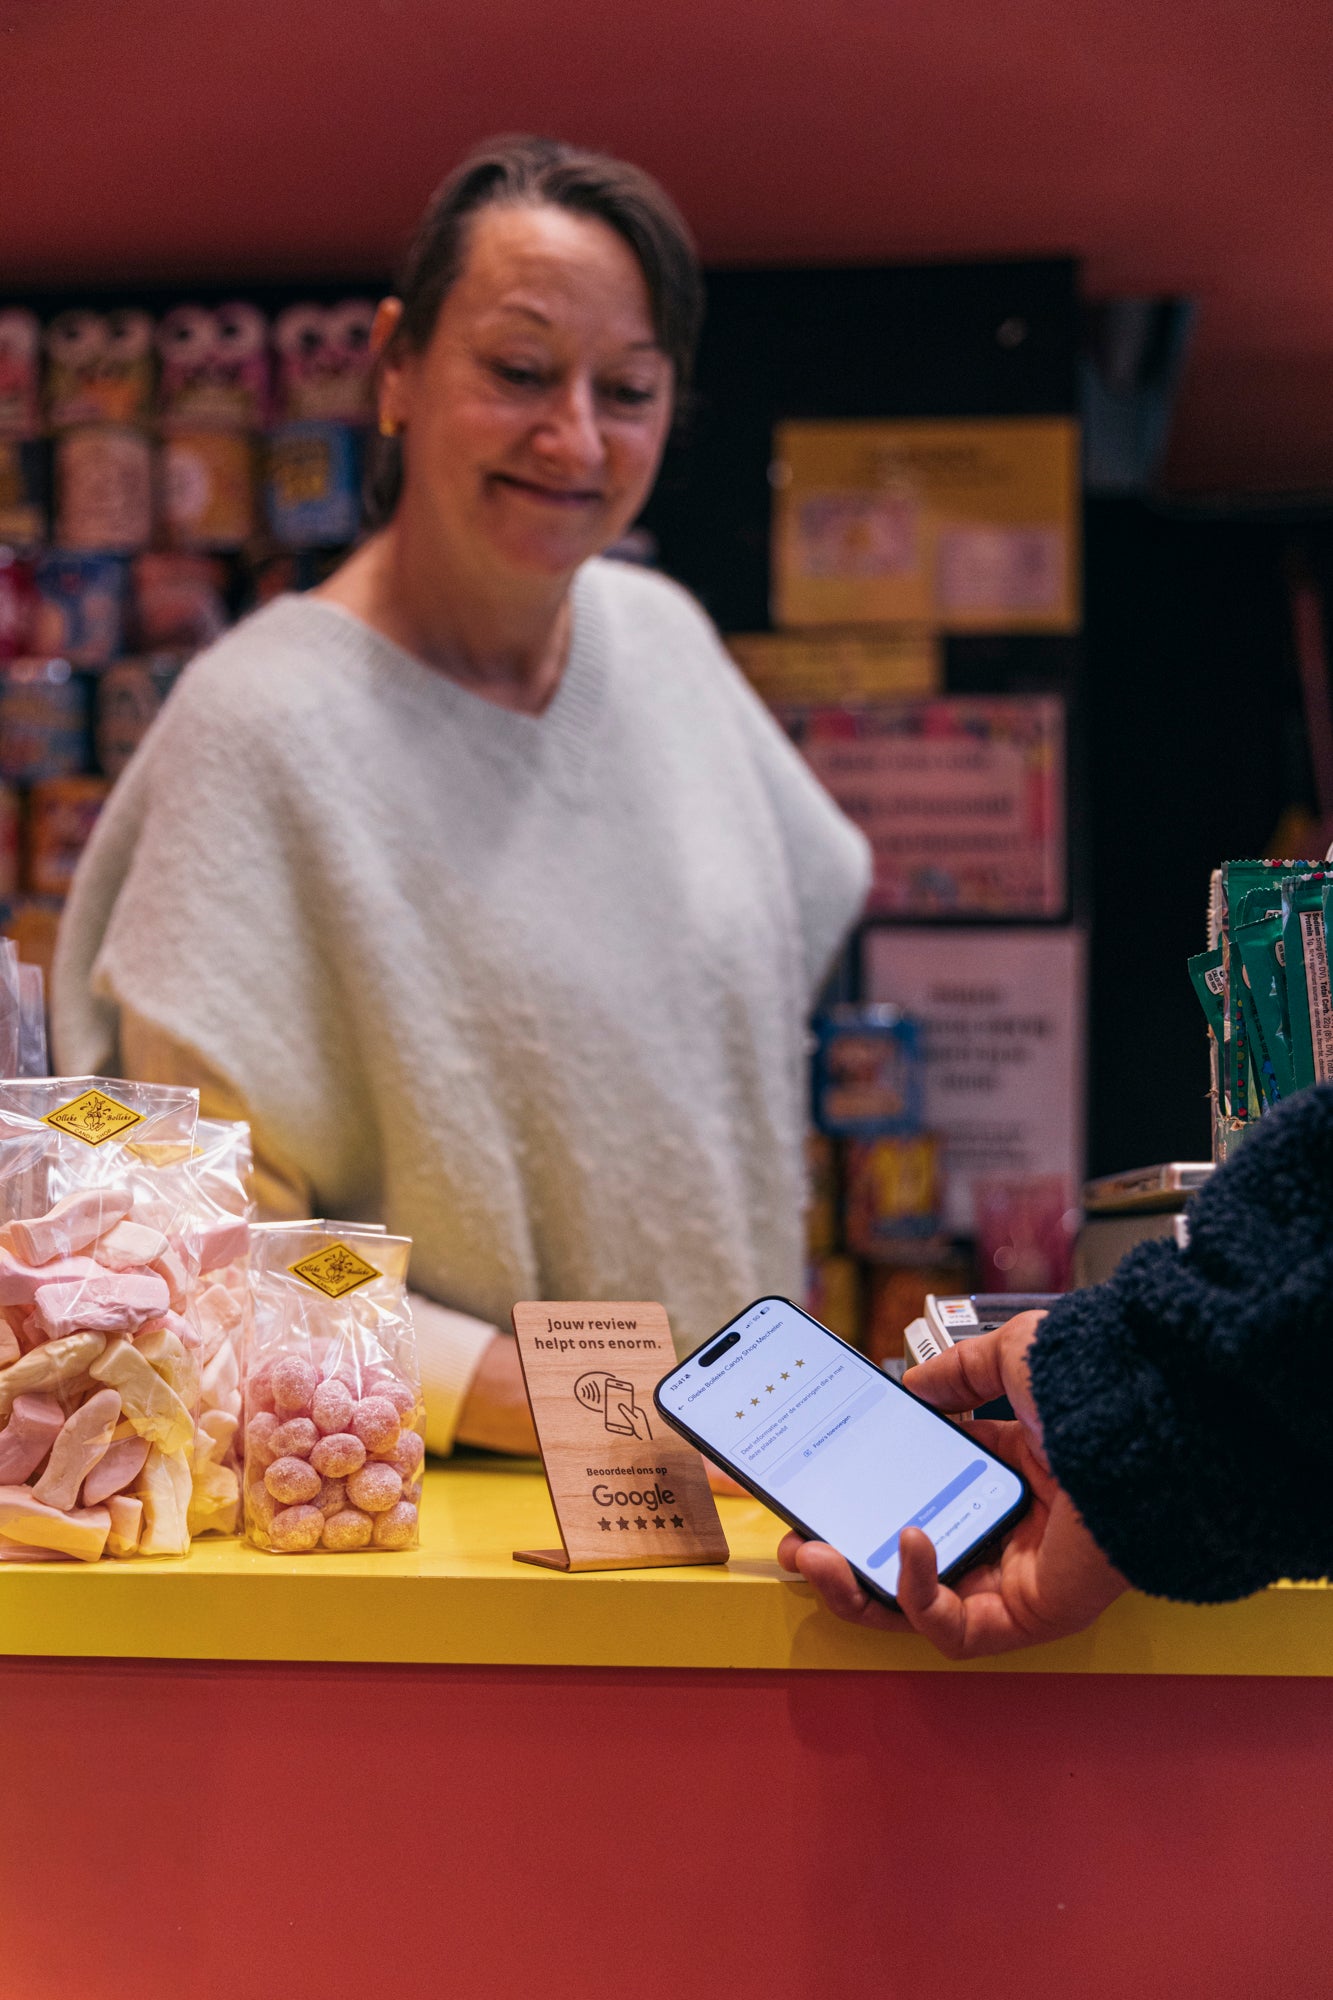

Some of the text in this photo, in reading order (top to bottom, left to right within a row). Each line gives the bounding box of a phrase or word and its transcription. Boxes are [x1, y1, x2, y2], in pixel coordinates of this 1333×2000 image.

[1304, 913, 1313, 936] Protein
[1312, 912, 1321, 936] Sodium
[1315, 937, 1323, 951] 5mg
[1322, 1017, 1331, 1028] 22g
[74, 1128, 112, 1140] CANDY SHOP
[548, 1318, 637, 1333] Jouw review
[534, 1337, 661, 1352] helpt ons enorm.
[724, 1354, 744, 1372] Candy
[742, 1342, 758, 1357] Shop
[756, 1320, 784, 1345] Mechelen
[670, 1377, 686, 1391] 13:41
[753, 1422, 778, 1445] informatie
[777, 1413, 790, 1424] over
[826, 1414, 851, 1437] toevoegen
[586, 1466, 668, 1476] Beoordeel ons op
[592, 1483, 676, 1511] Google
